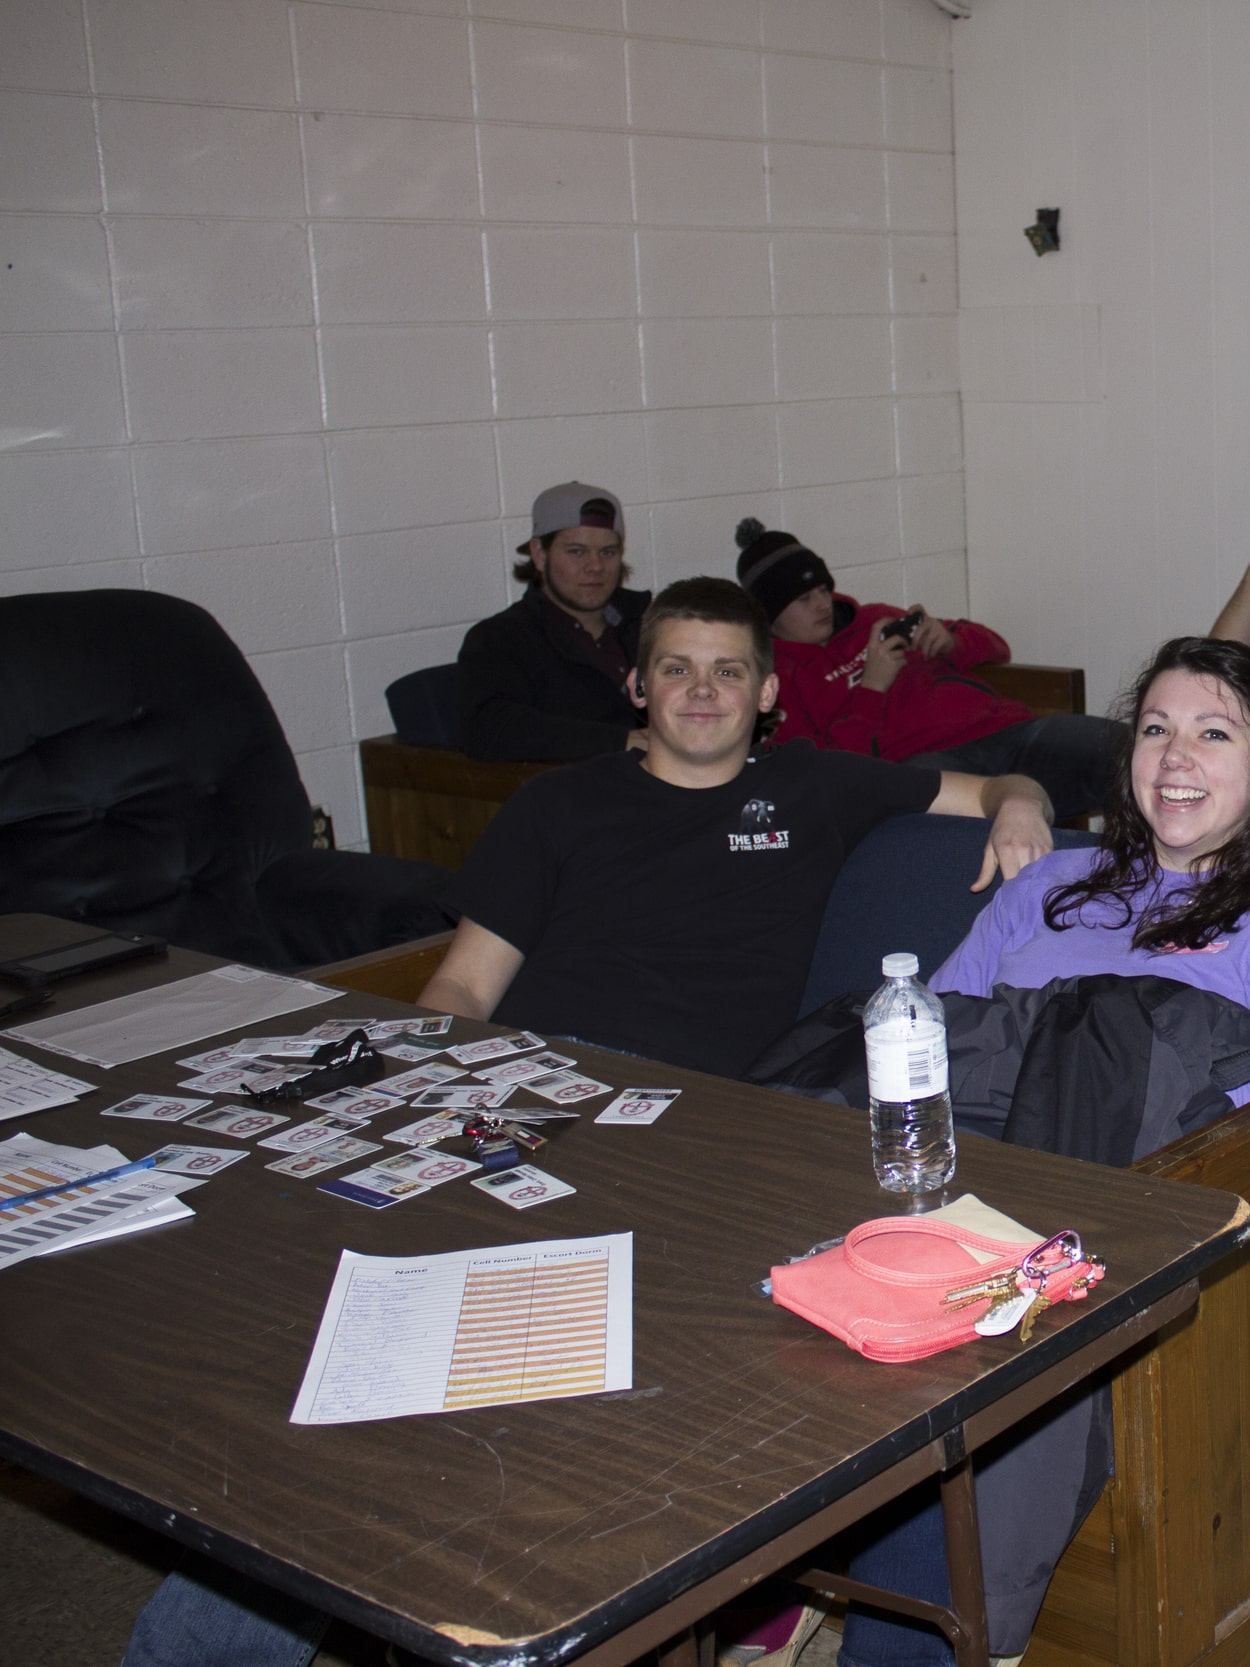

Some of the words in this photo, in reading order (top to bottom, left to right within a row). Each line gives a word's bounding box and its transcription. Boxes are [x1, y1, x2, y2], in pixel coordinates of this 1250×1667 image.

[728, 834, 751, 845] THE
[753, 831, 789, 844] BEAST
[754, 842, 789, 850] SOUTHEAST
[493, 1256, 532, 1264] Number
